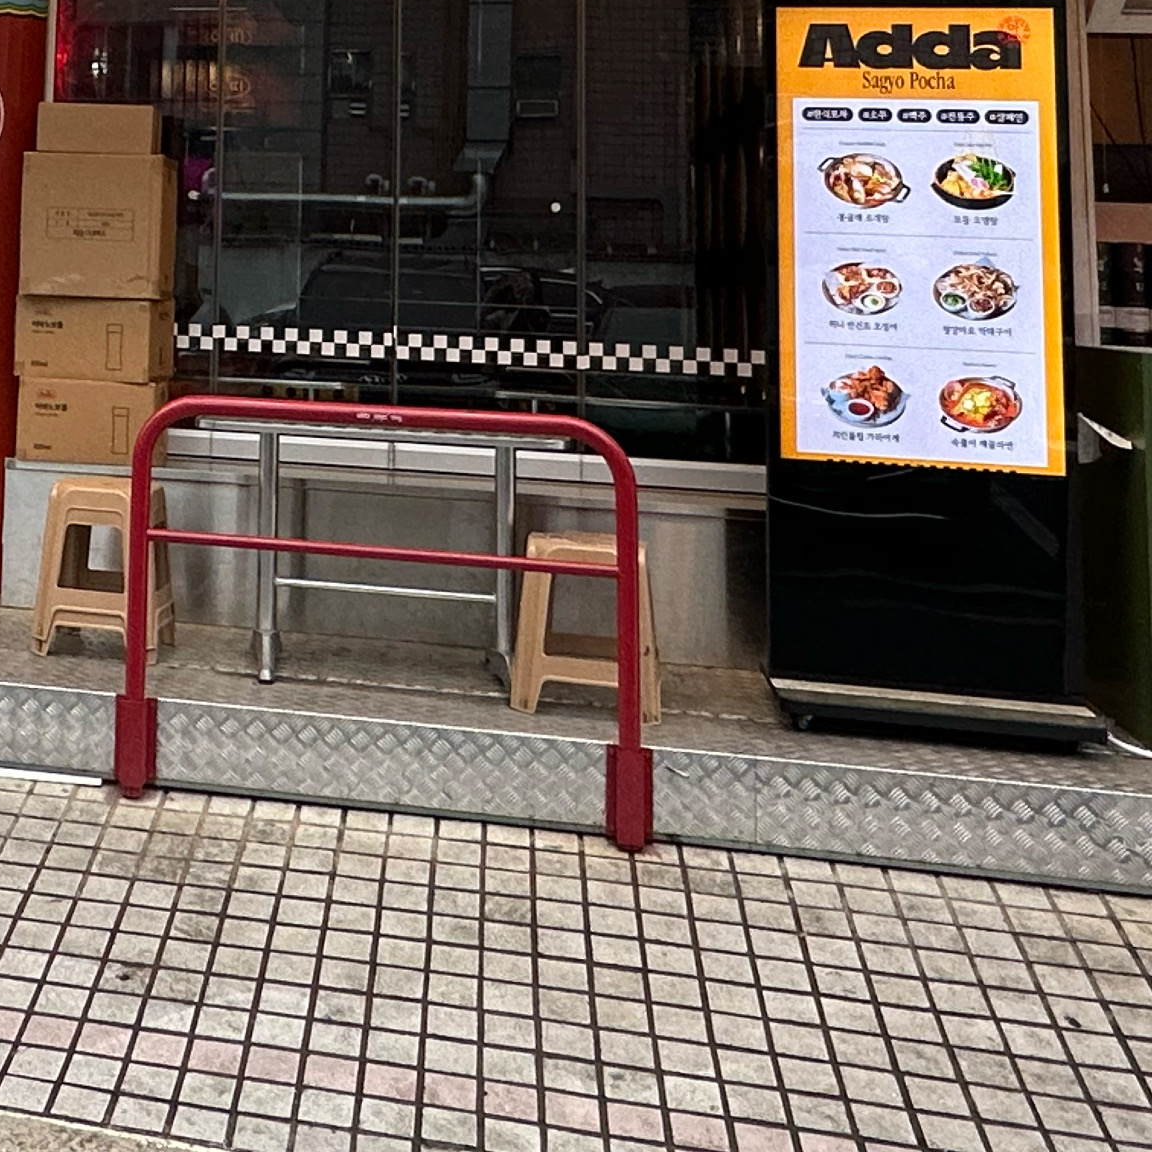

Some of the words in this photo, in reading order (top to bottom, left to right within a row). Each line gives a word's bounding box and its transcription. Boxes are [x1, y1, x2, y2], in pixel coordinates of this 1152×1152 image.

[798, 23, 1022, 70] Adda
[862, 71, 905, 94] Sagyo
[910, 71, 956, 90] Pocha
